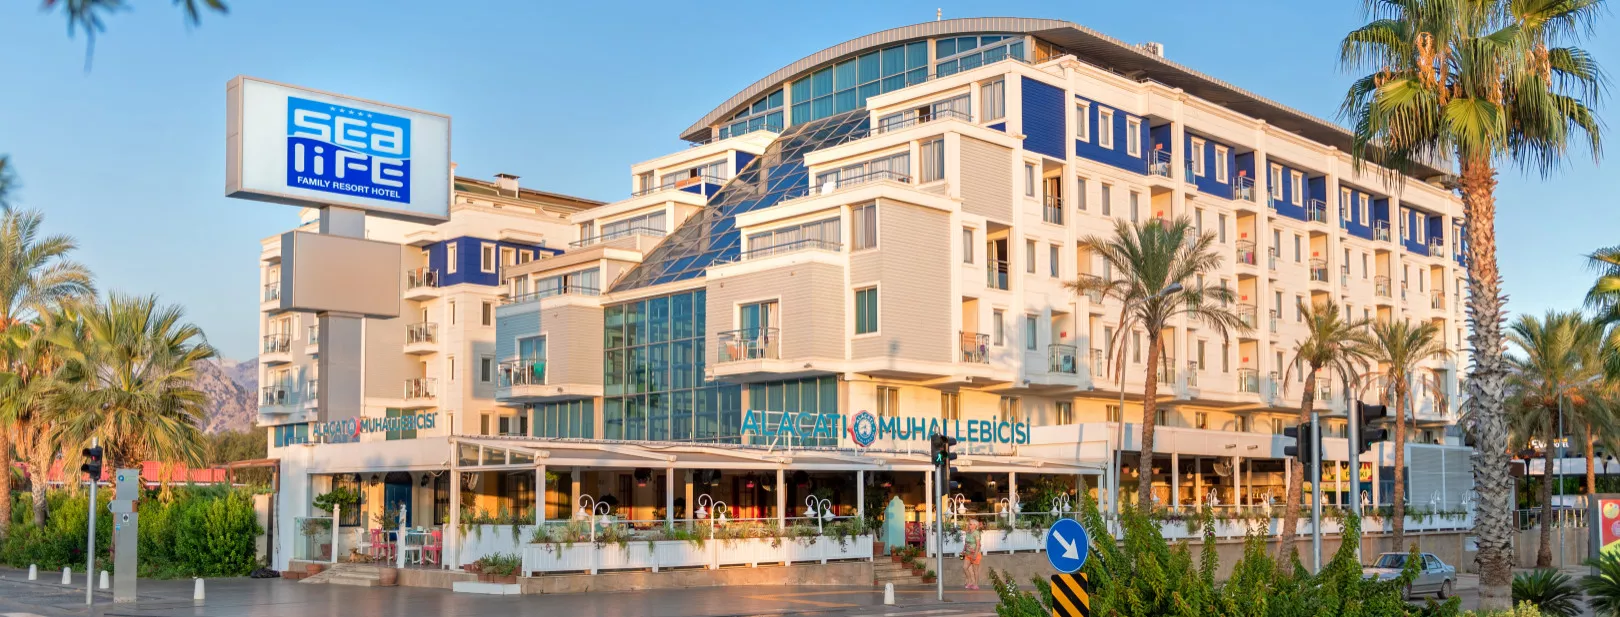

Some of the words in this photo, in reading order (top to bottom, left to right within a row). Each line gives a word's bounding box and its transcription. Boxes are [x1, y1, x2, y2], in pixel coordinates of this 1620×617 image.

[297, 176, 331, 188] FAMILY
[333, 180, 369, 193] RESORT
[371, 186, 401, 199] HOTEL
[313, 419, 347, 437] ALAÇAT
[740, 409, 847, 443] ALAÇATI
